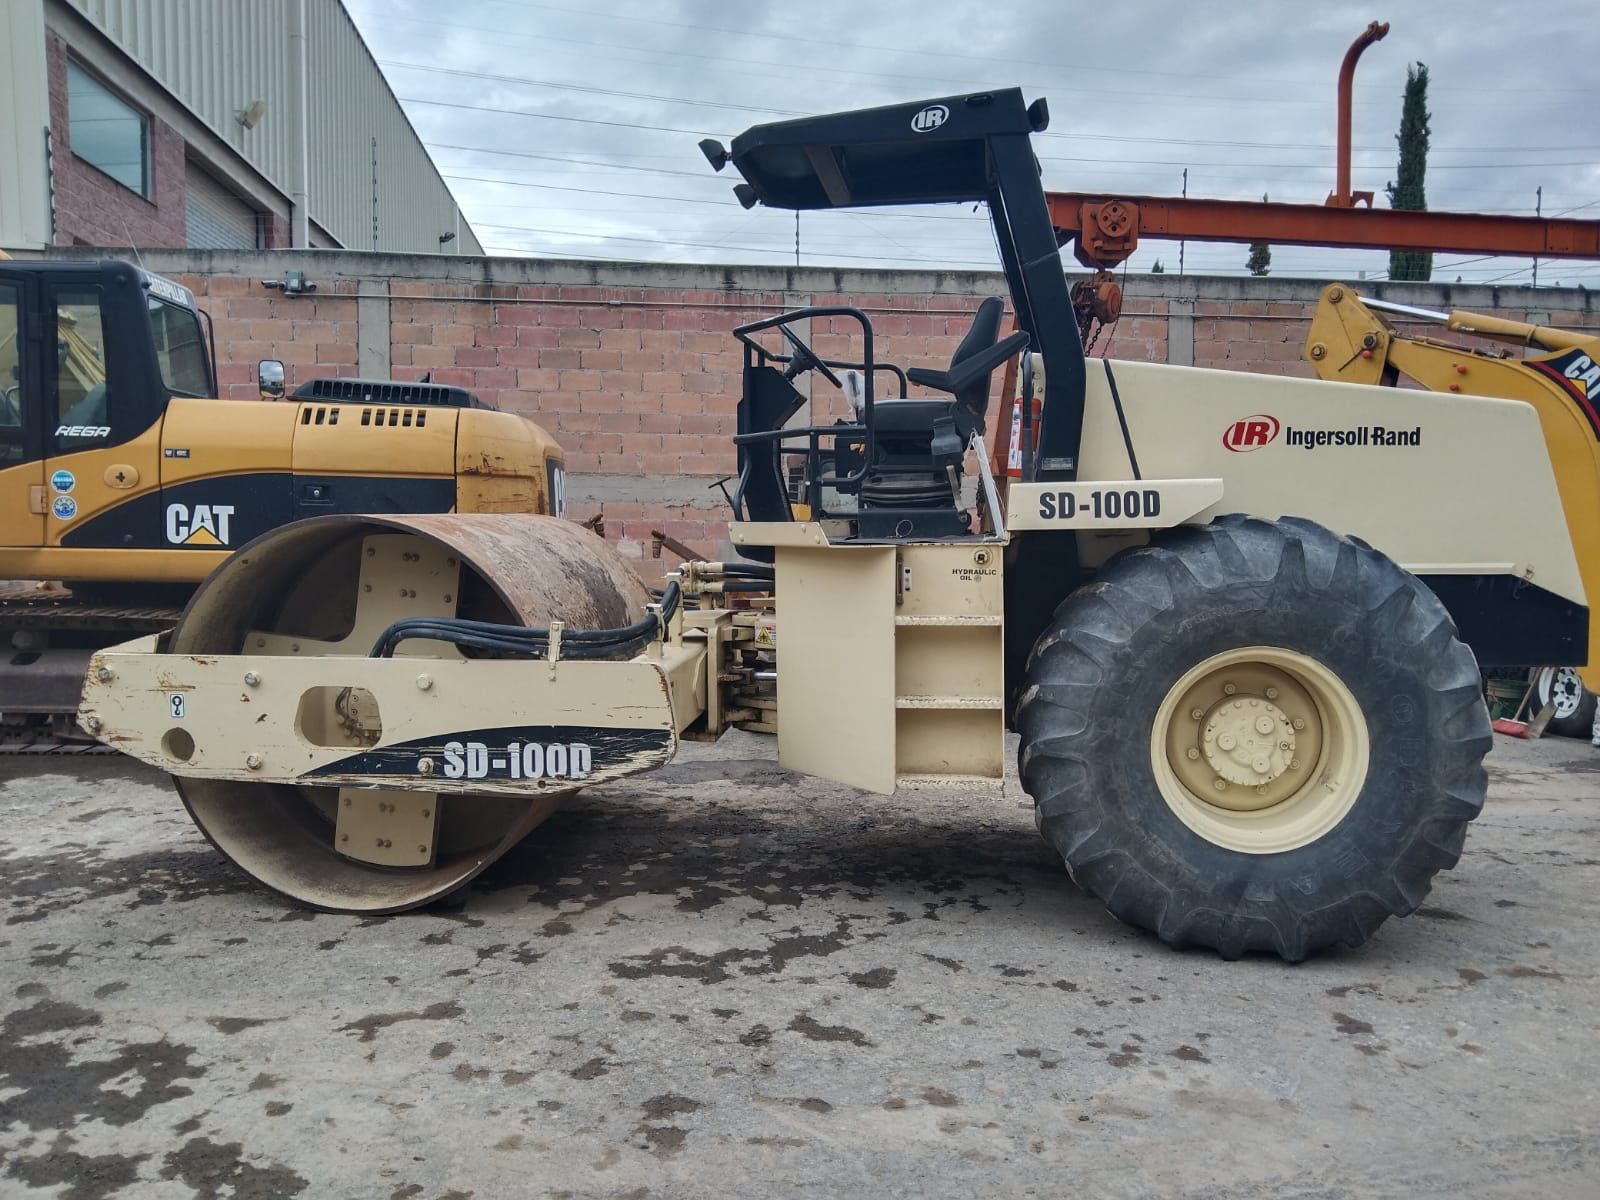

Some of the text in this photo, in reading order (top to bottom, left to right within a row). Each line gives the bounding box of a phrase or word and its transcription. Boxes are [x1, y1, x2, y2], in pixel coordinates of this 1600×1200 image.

[915, 108, 944, 130] IR
[1229, 419, 1273, 448] IR
[1286, 426, 1369, 450] Ingersoll
[1039, 490, 1161, 519] SD-100D
[166, 503, 235, 545] CAT
[952, 568, 997, 576] HYDRAULIC
[443, 741, 592, 779] SD-100D
